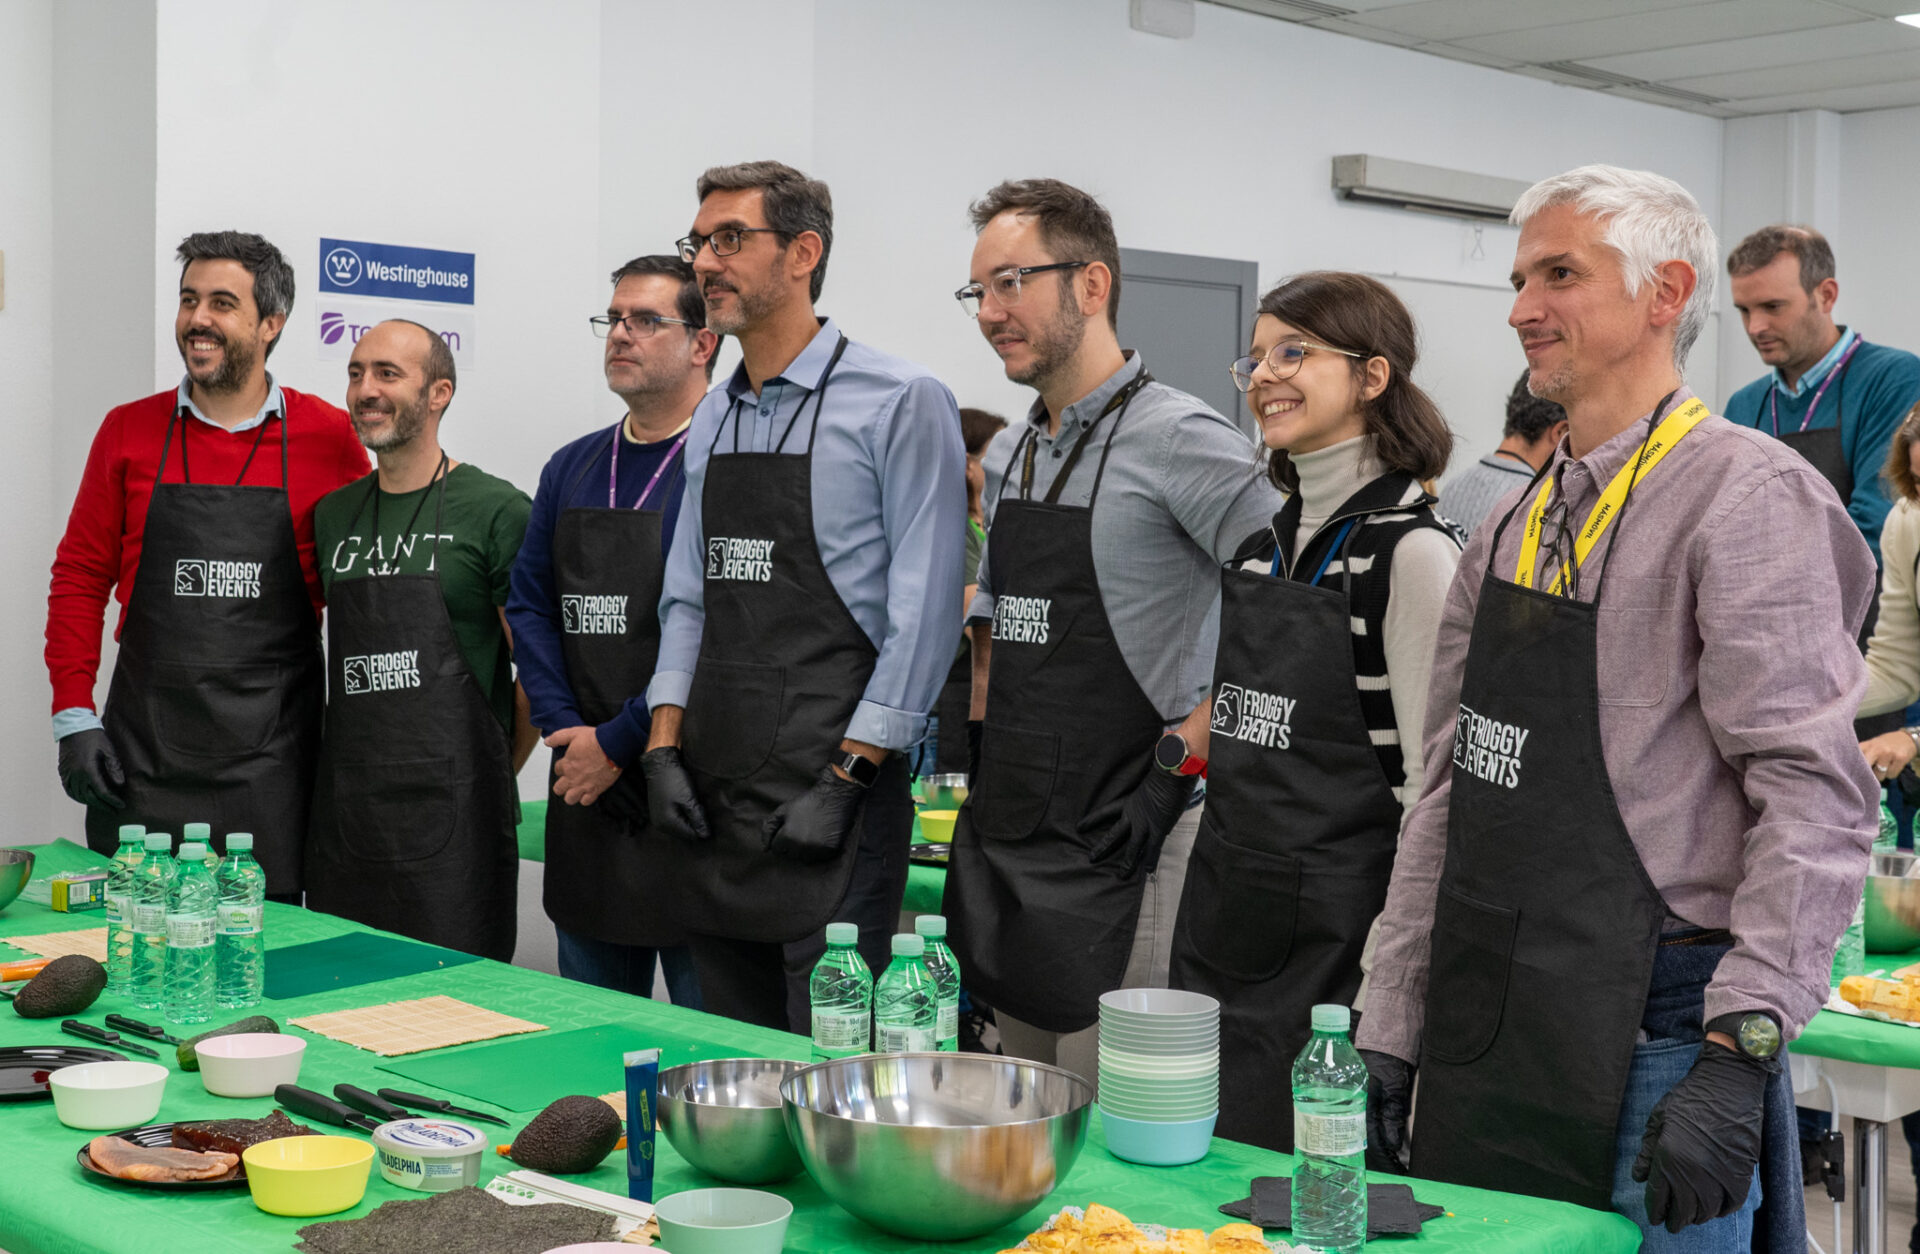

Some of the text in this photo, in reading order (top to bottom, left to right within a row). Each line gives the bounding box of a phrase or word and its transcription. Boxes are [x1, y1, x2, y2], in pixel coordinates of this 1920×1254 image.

[366, 260, 469, 288] Westinghouse
[332, 534, 454, 573] GANT
[728, 538, 775, 561] FROGGY
[208, 560, 262, 581] FROGGY
[724, 559, 772, 582] EVENTS
[207, 579, 261, 598] EVENTS
[583, 595, 628, 615] FROGGY
[1002, 596, 1051, 621] FROGGY
[582, 614, 627, 634] EVENTS
[1002, 619, 1050, 644] EVENTS
[370, 650, 419, 673] FROGGY
[371, 669, 421, 691] EVENTS
[1241, 689, 1296, 724] FROGGY
[1237, 716, 1291, 750] EVENTS
[1469, 713, 1530, 758] FROGGY
[1467, 743, 1522, 789] EVENTS
